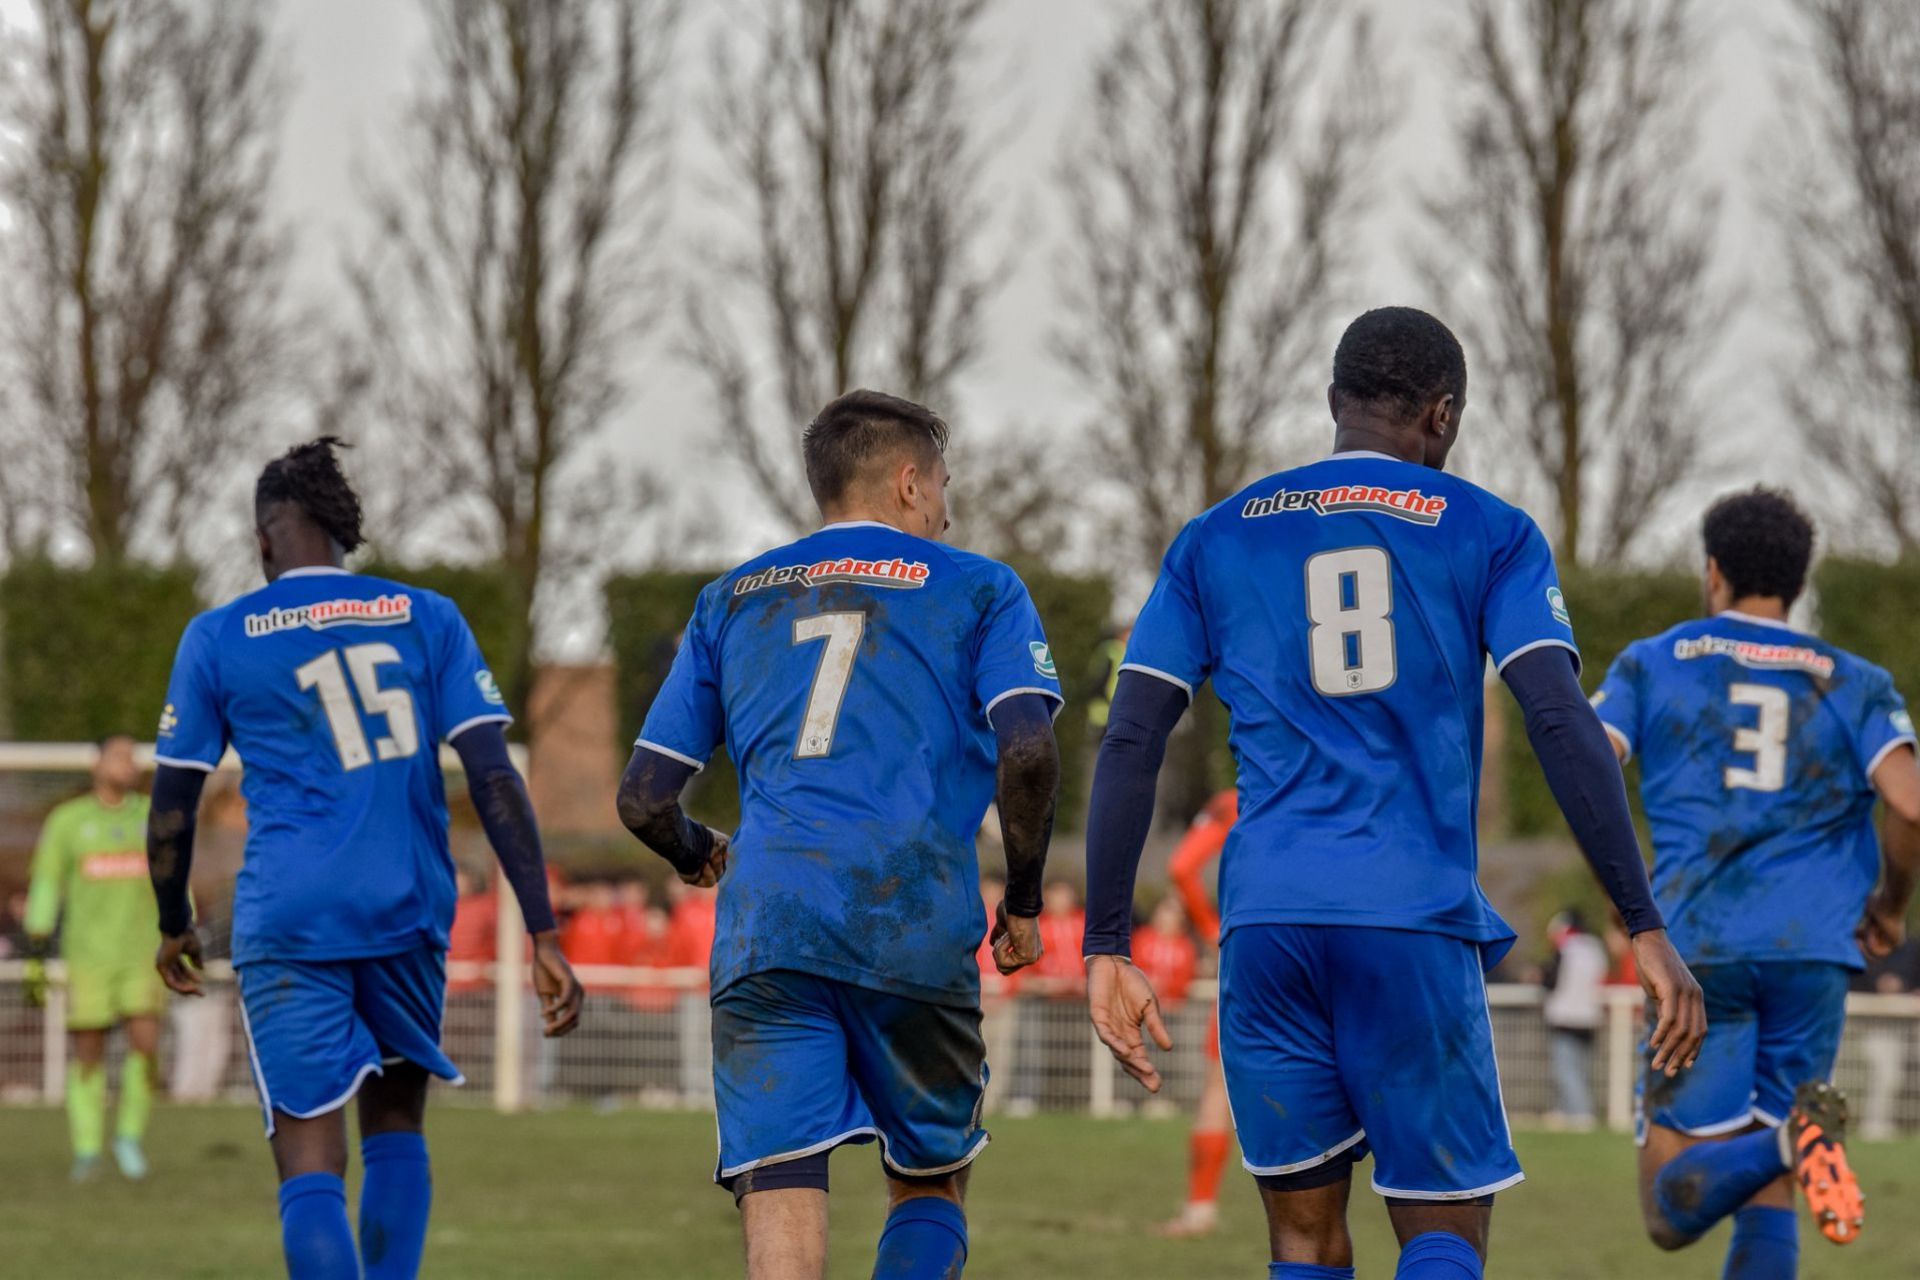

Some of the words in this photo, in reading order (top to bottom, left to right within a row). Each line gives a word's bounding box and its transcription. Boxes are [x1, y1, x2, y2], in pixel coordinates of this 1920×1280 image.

[792, 611, 866, 760] 7
[1304, 545, 1398, 697] 8
[295, 642, 419, 772] 15
[1724, 683, 1790, 792] 3
